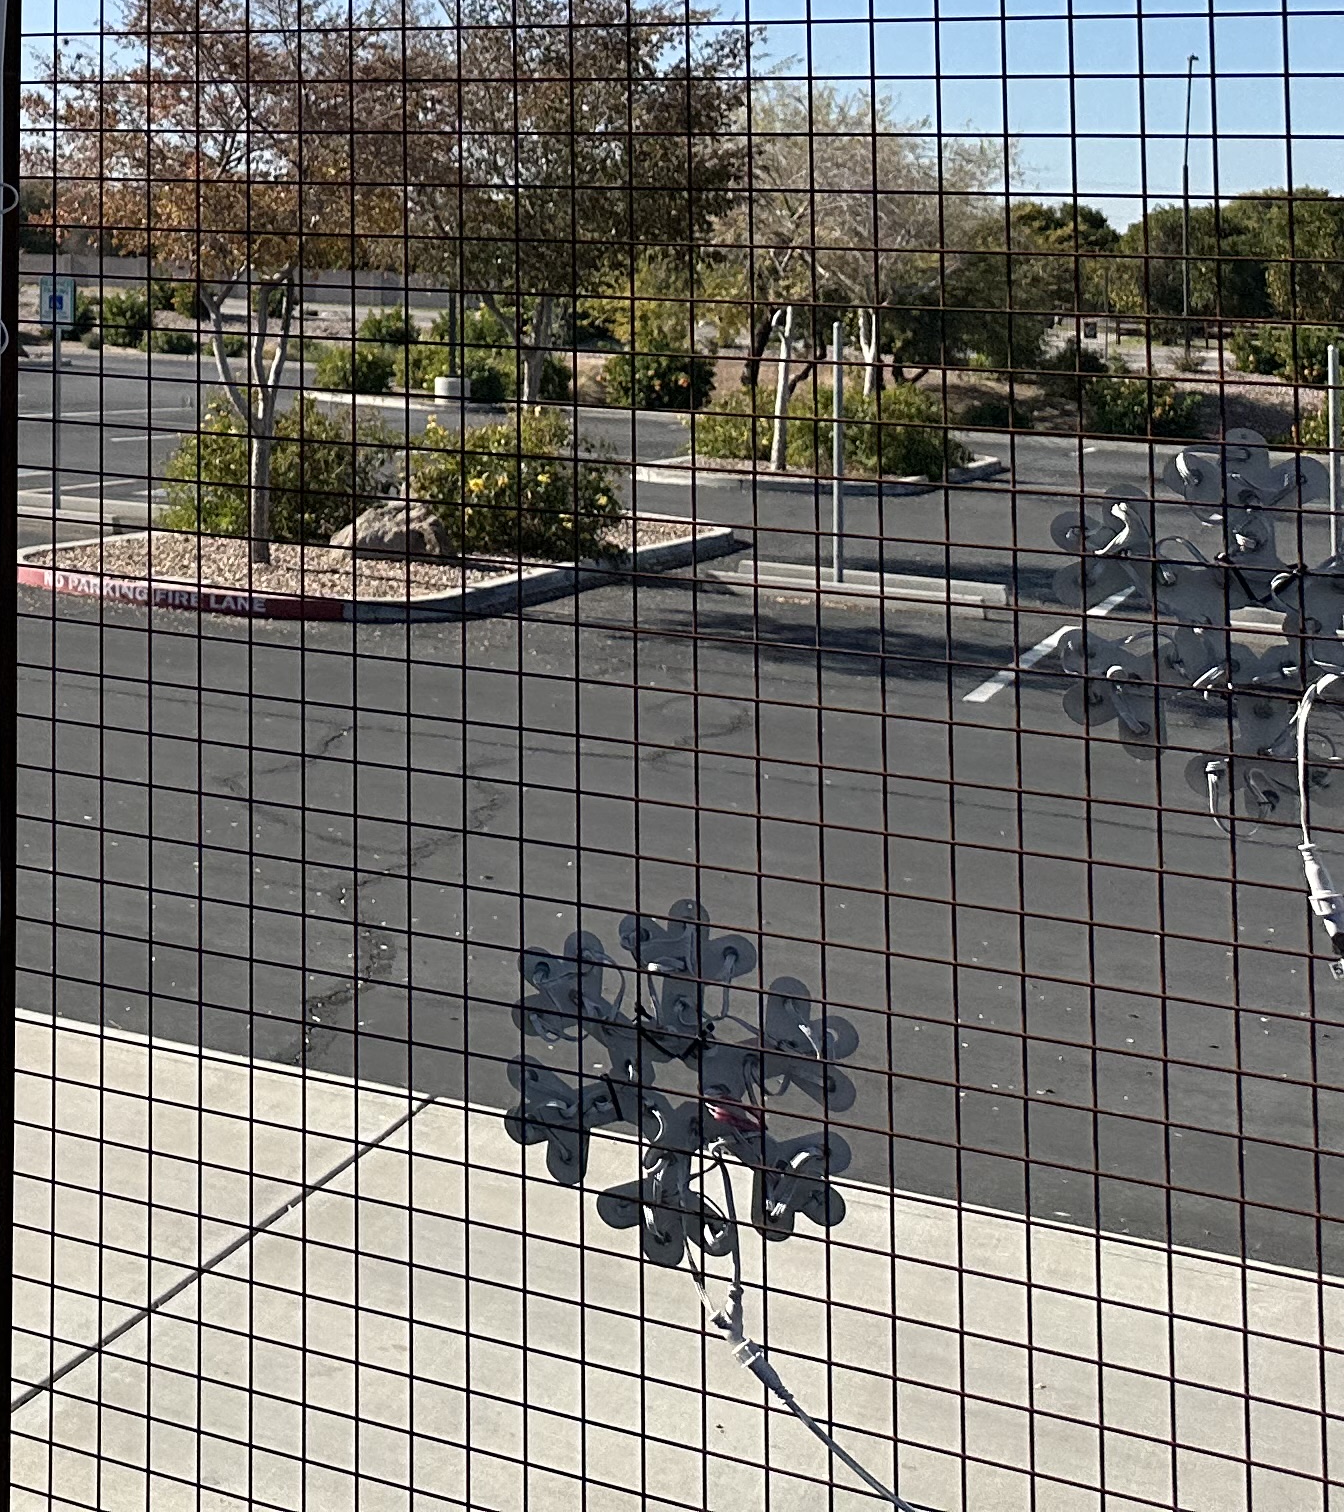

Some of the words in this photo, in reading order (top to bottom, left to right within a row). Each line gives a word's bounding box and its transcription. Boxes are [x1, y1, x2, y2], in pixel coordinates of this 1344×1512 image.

[43, 571, 65, 588] NO
[68, 575, 149, 600] PARKING
[154, 588, 200, 606] FIRE
[209, 593, 267, 613] LANE
